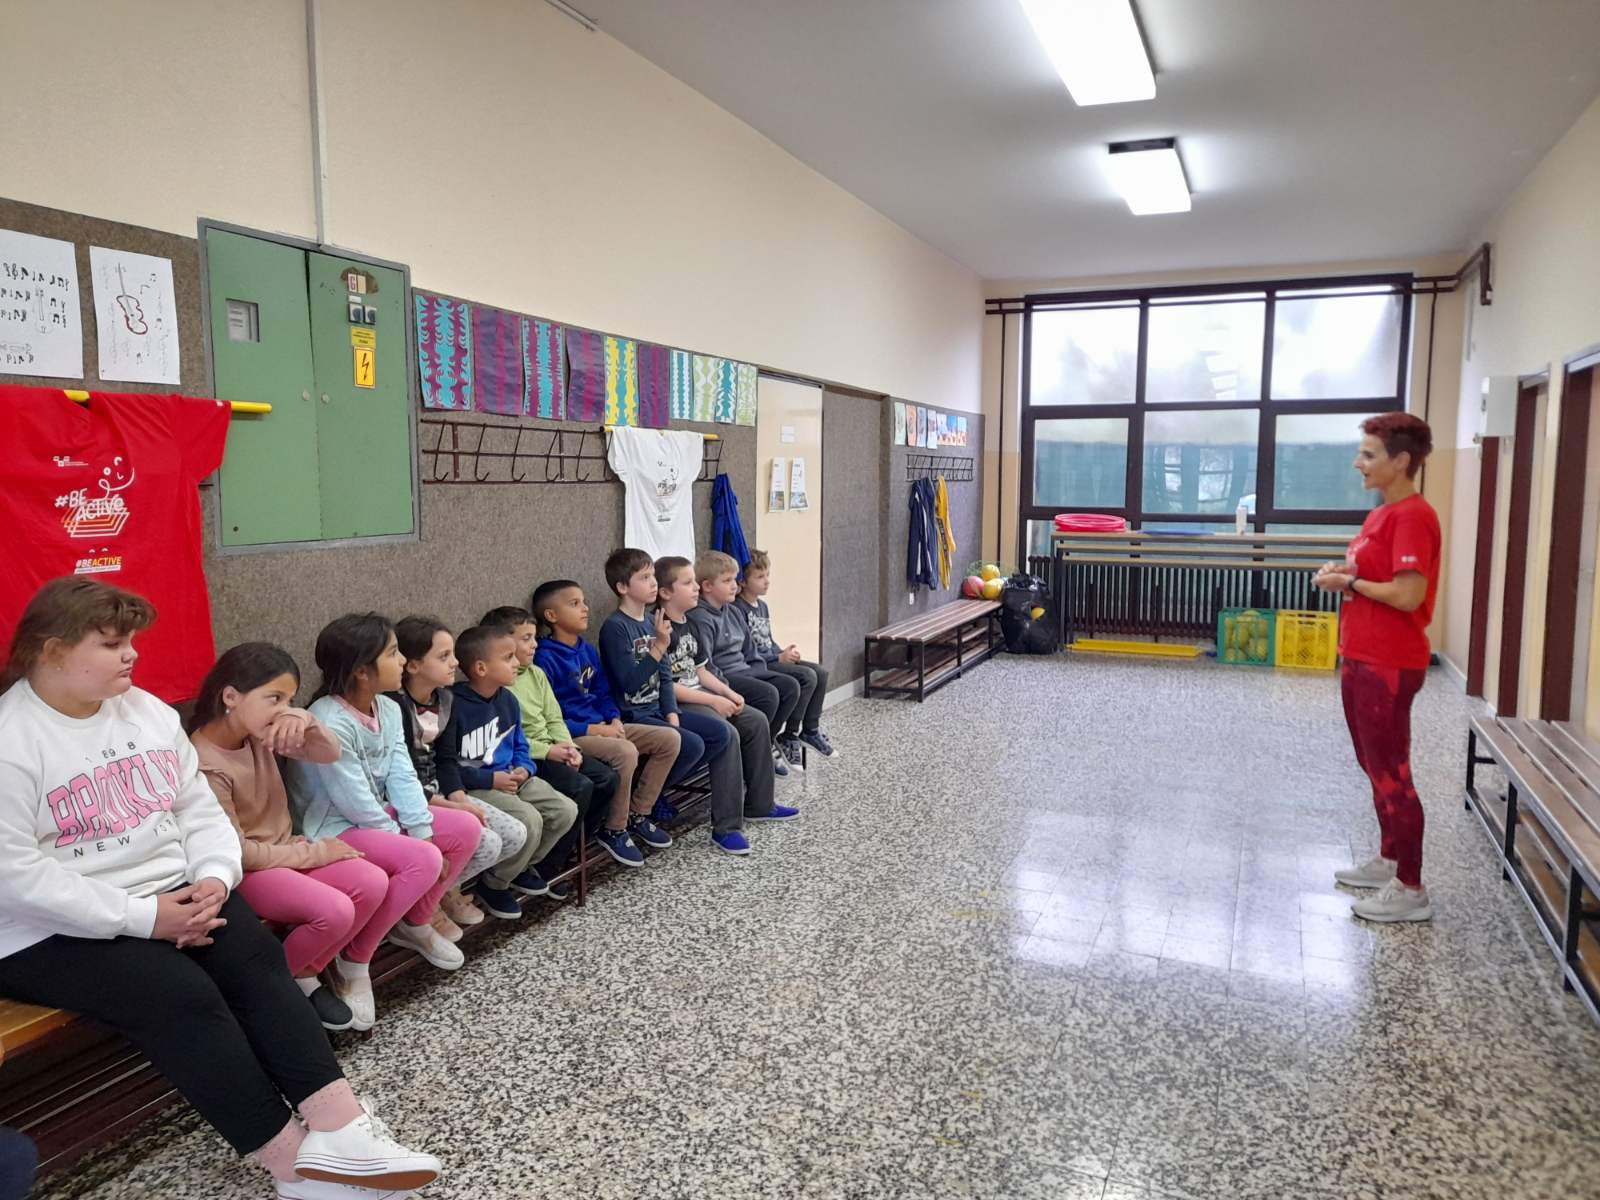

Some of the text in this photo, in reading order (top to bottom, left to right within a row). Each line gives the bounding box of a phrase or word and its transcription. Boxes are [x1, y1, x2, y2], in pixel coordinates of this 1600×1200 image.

[76, 556, 122, 568] #BEACTIVE
[460, 716, 500, 760] NIKE
[74, 835, 131, 857] NEW
